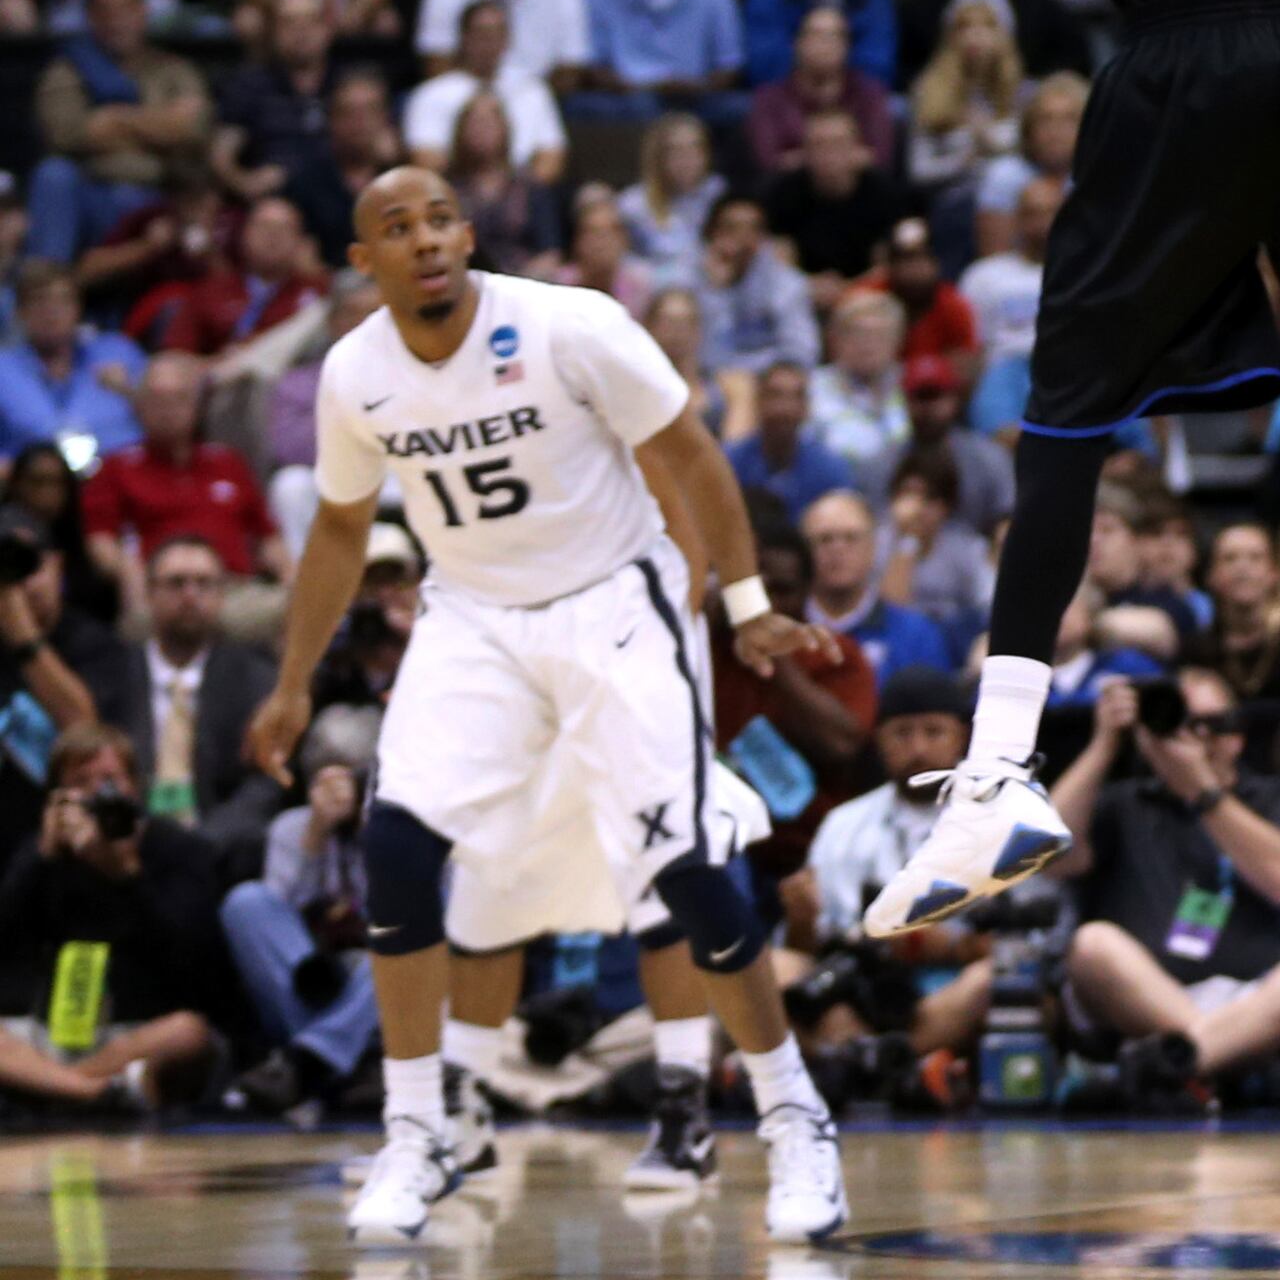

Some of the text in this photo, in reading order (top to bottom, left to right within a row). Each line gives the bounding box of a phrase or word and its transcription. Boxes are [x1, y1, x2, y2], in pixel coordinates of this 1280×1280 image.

[376, 406, 547, 457] XAVIER
[425, 456, 531, 526] 15
[635, 799, 678, 851] X
